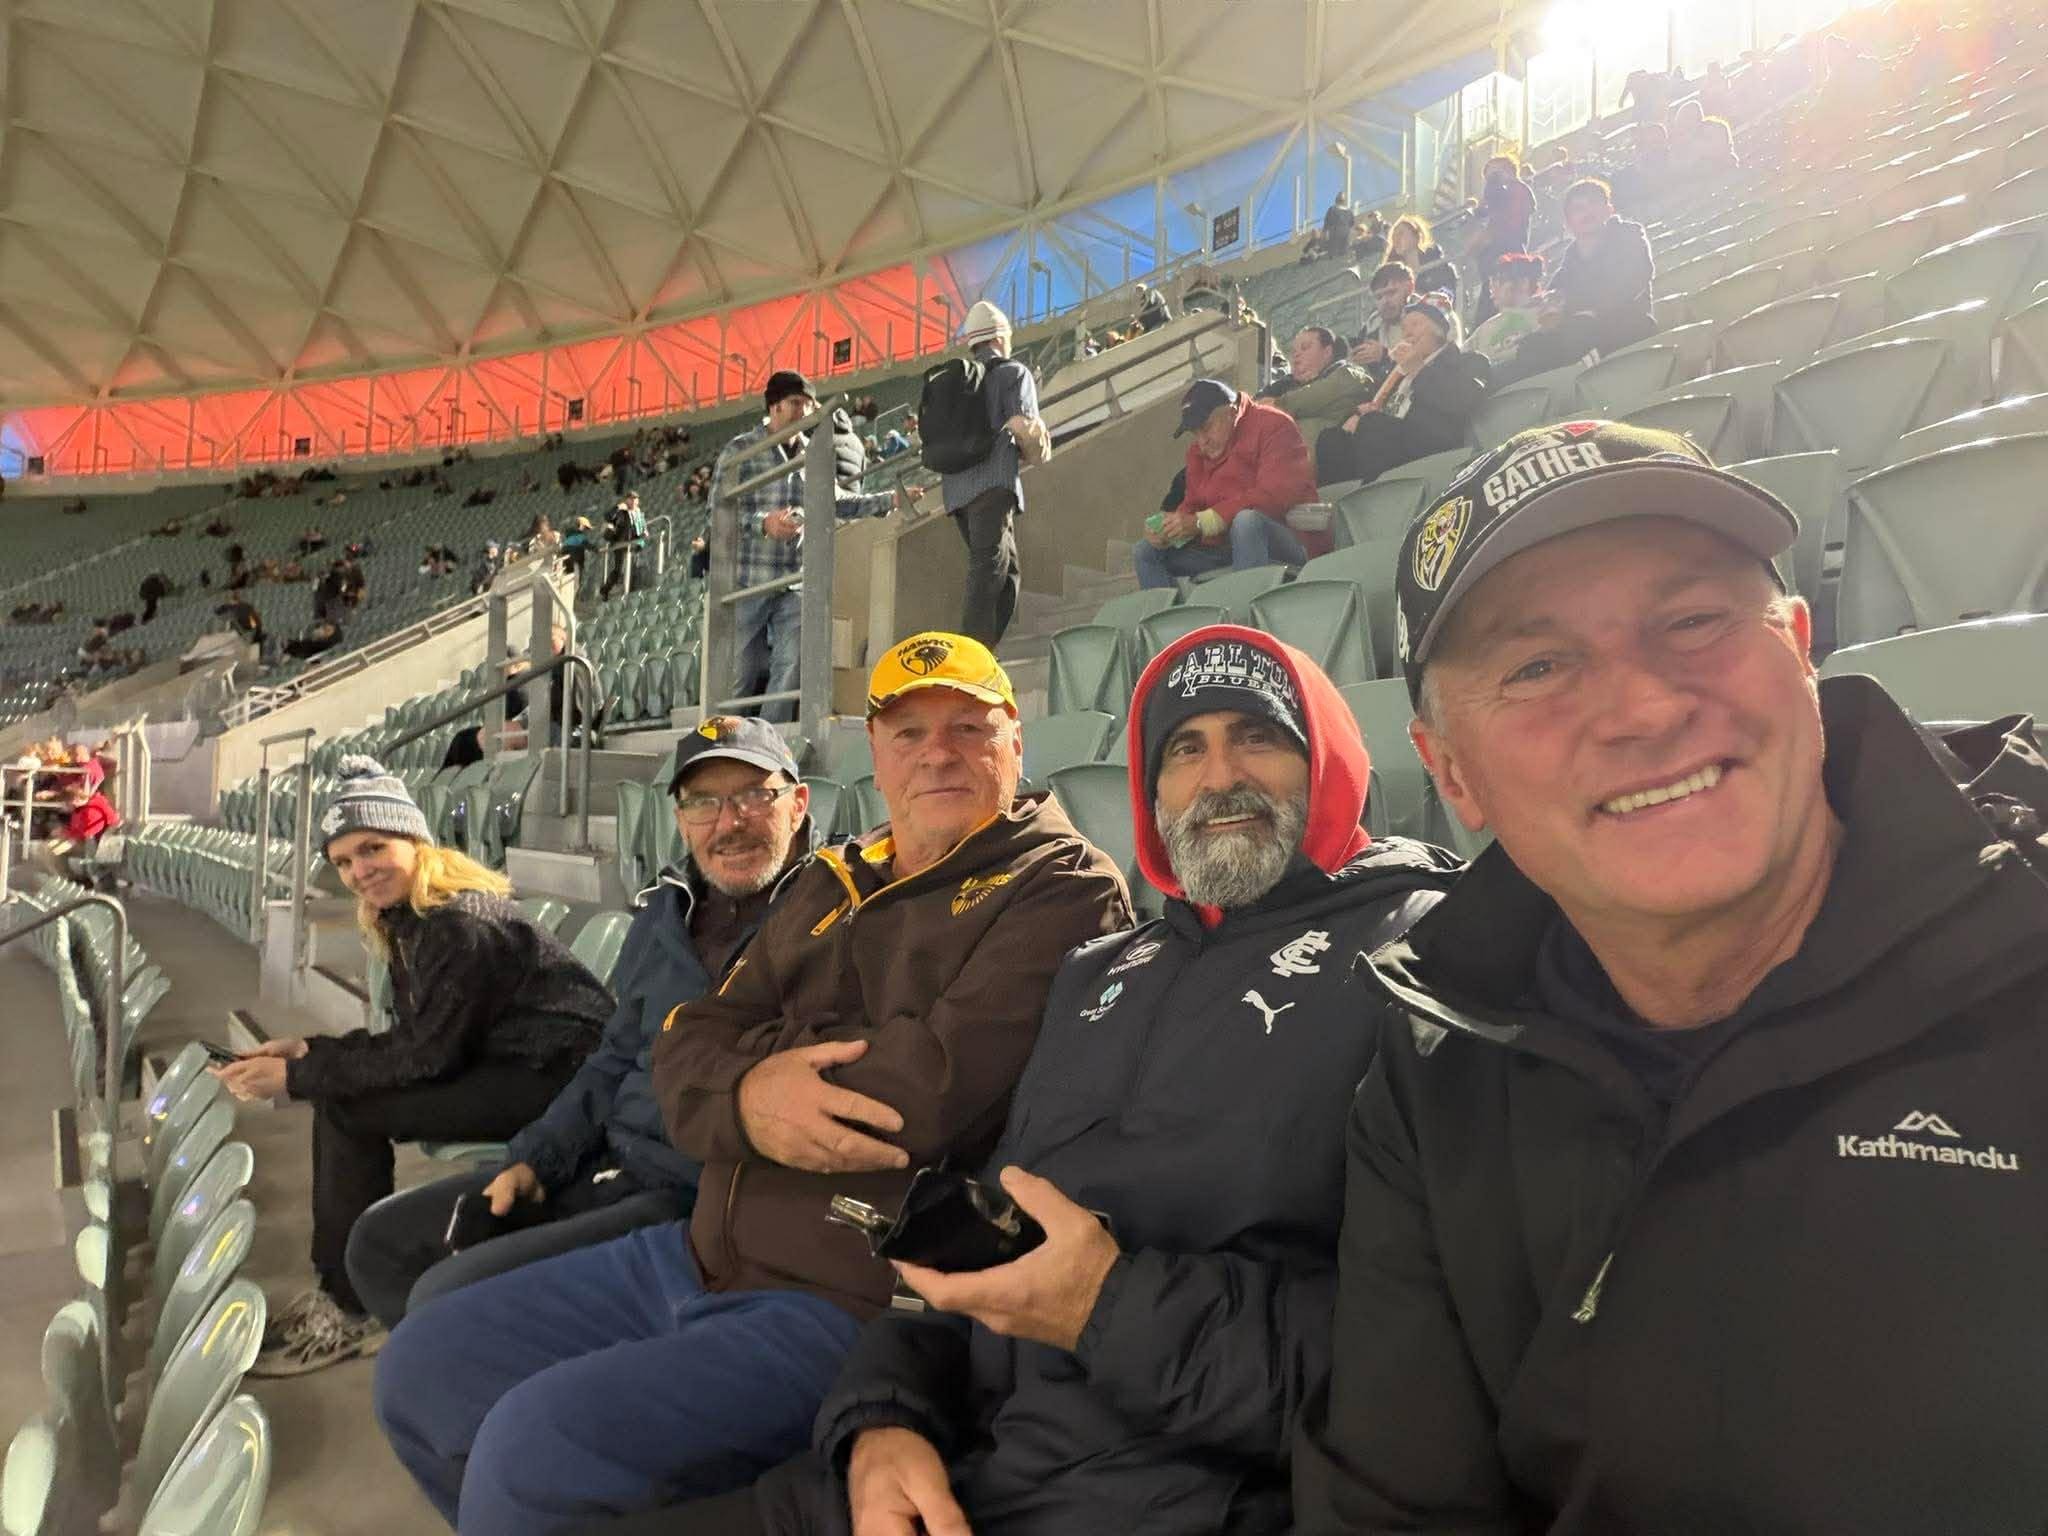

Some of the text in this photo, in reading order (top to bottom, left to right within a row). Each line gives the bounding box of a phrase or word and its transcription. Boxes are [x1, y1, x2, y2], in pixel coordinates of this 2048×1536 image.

[1482, 442, 1608, 507] GATHER
[897, 639, 954, 657] HAWKS
[1837, 1134, 2019, 1170] Kathmandu
